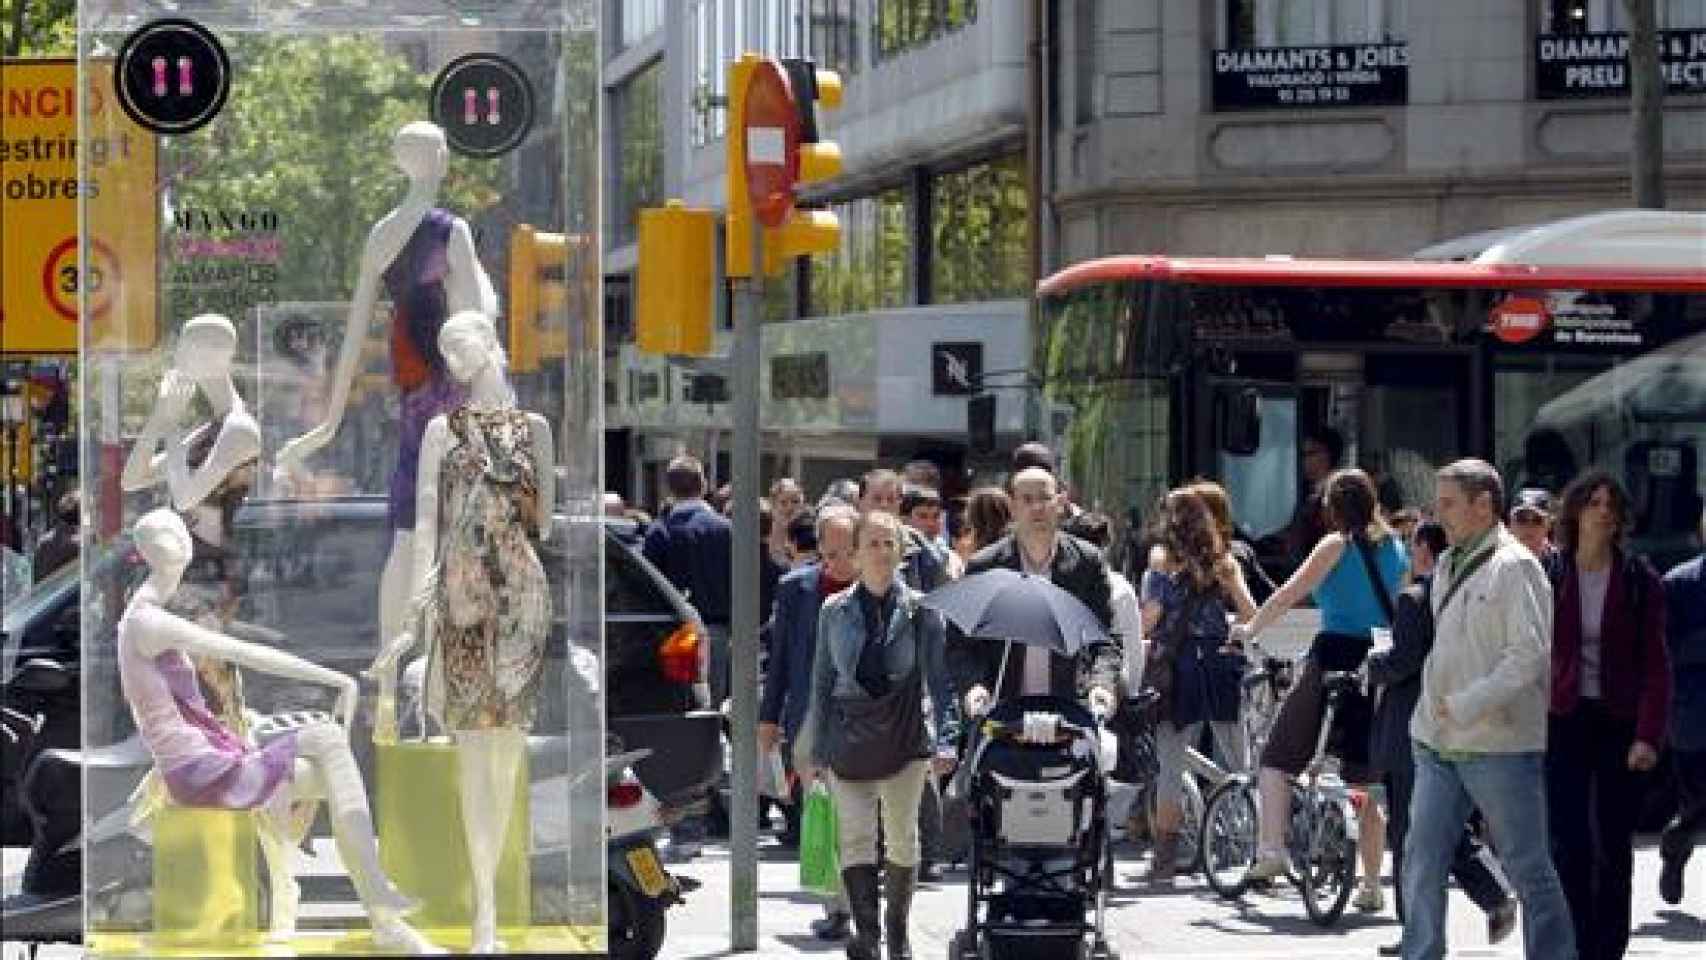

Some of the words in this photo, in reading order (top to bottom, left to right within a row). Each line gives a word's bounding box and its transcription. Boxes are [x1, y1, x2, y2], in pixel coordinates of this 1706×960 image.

[1216, 50, 1332, 72] DIAMANTS
[1337, 51, 1350, 69] &
[1354, 45, 1408, 71] JOIES
[1566, 64, 1630, 88] PREU
[6, 173, 100, 200] obres
[174, 208, 279, 232] MANGO
[61, 265, 103, 294] 30
